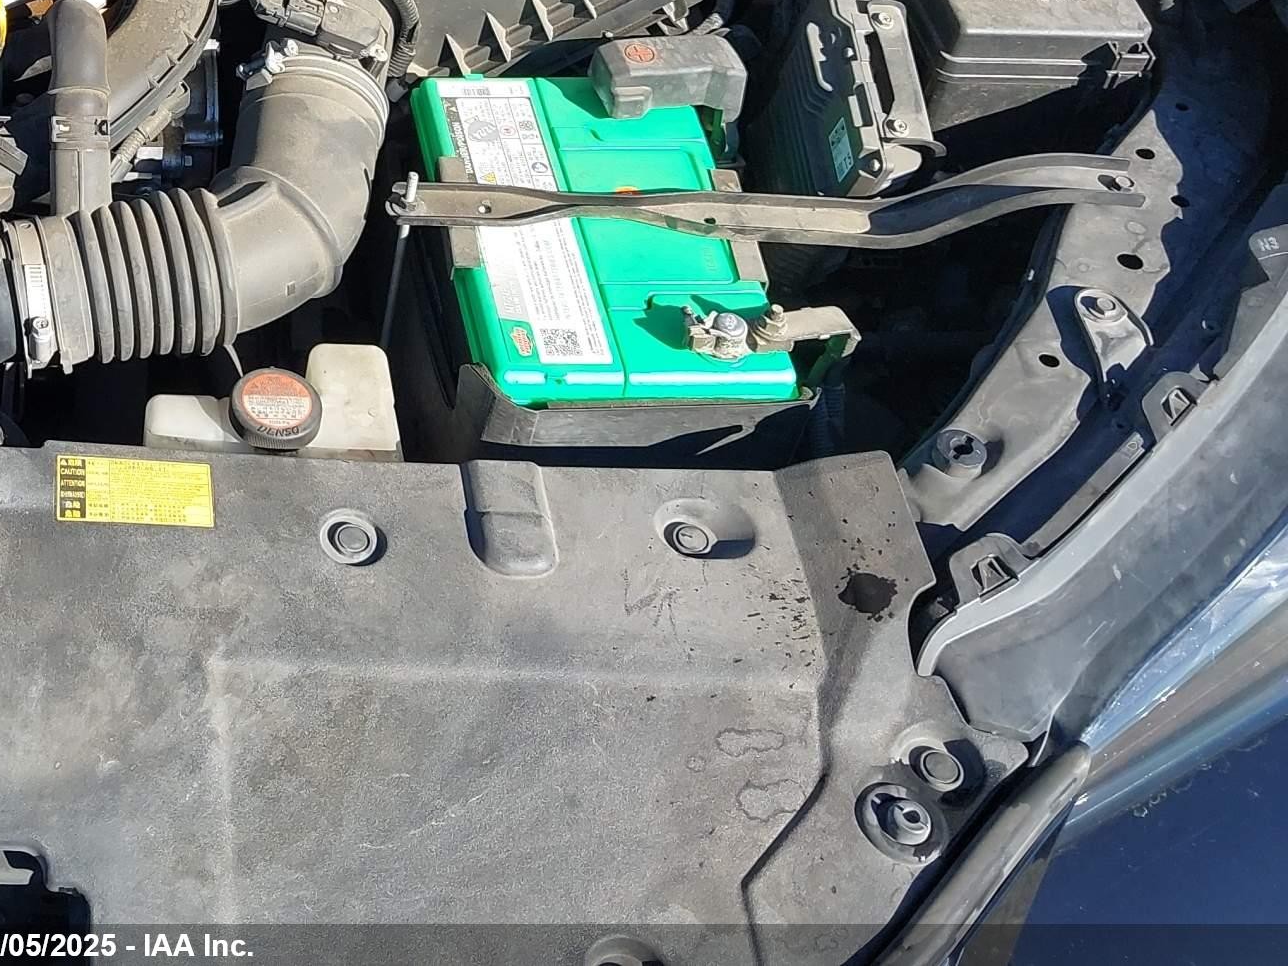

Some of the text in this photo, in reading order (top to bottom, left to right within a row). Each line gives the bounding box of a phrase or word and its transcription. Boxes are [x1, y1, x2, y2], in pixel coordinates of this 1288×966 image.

[256, 425, 300, 438] DENSO
[60, 467, 85, 476] CAUTION
[60, 478, 86, 487] ATTENTION
